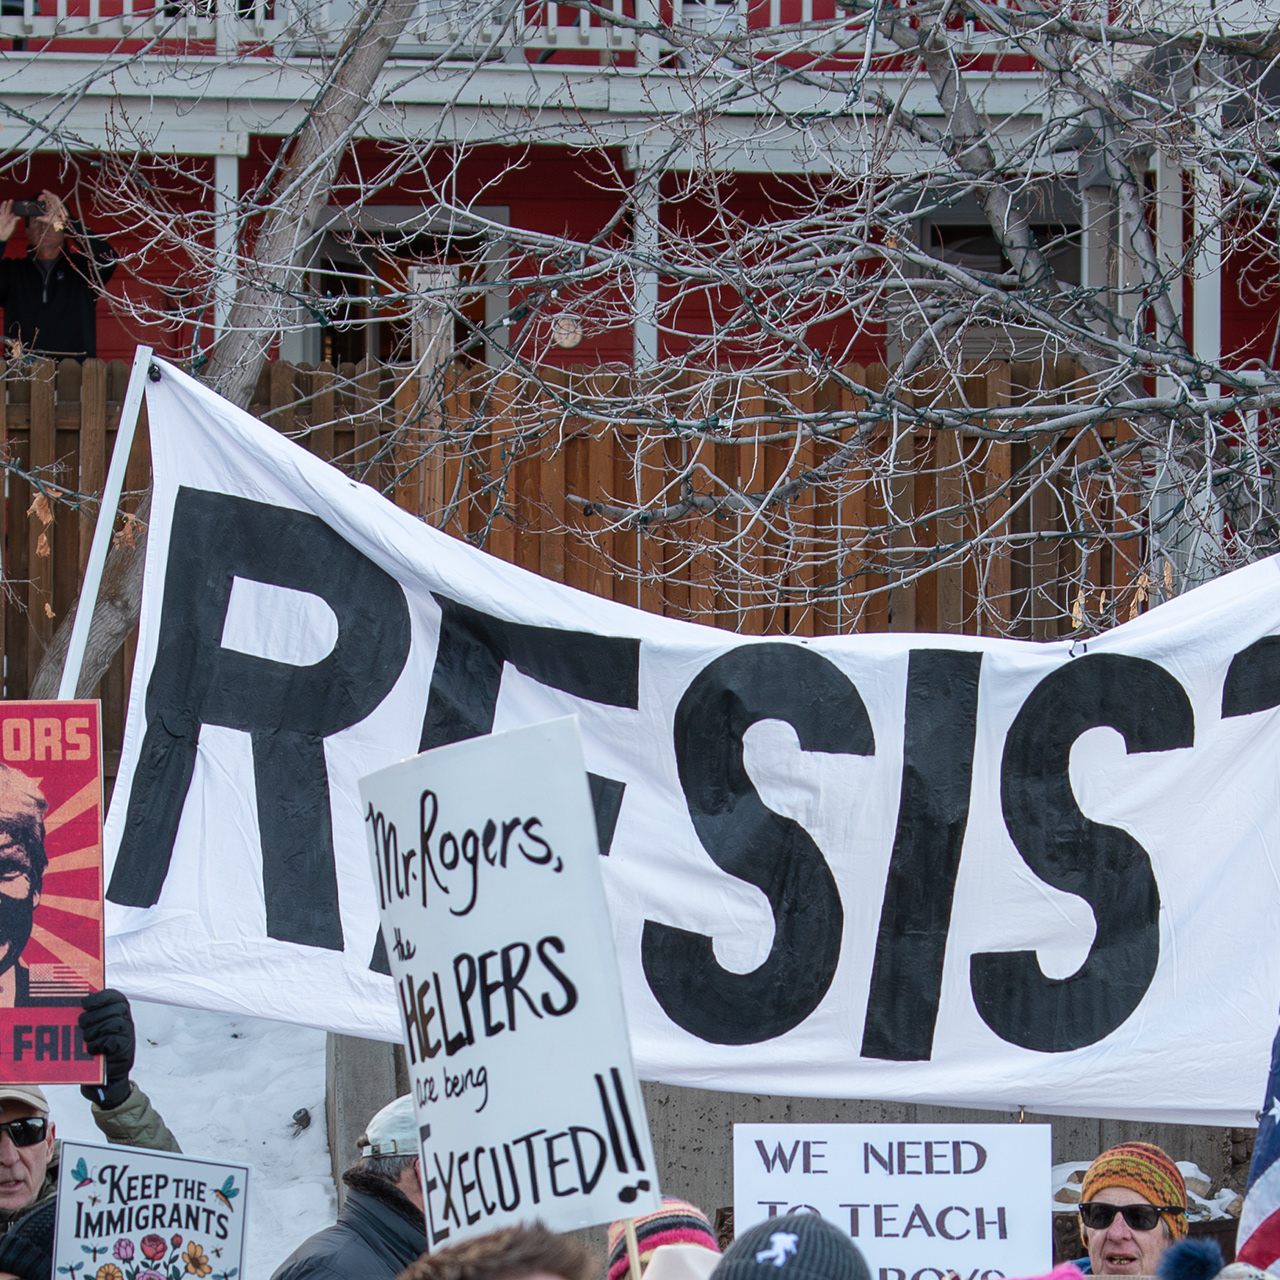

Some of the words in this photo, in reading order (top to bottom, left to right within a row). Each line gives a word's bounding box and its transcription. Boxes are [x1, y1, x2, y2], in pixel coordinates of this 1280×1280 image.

[398, 935, 578, 1066] HELPERS
[13, 1025, 95, 1062] FAIL
[444, 1065, 489, 1113] being
[754, 1139, 829, 1174] WE
[863, 1140, 988, 1176] NEED
[98, 1164, 169, 1205] KEEP
[172, 1178, 207, 1203] THE
[74, 1201, 229, 1240] IMMIGRANTS
[839, 1203, 1008, 1240] TEACH
